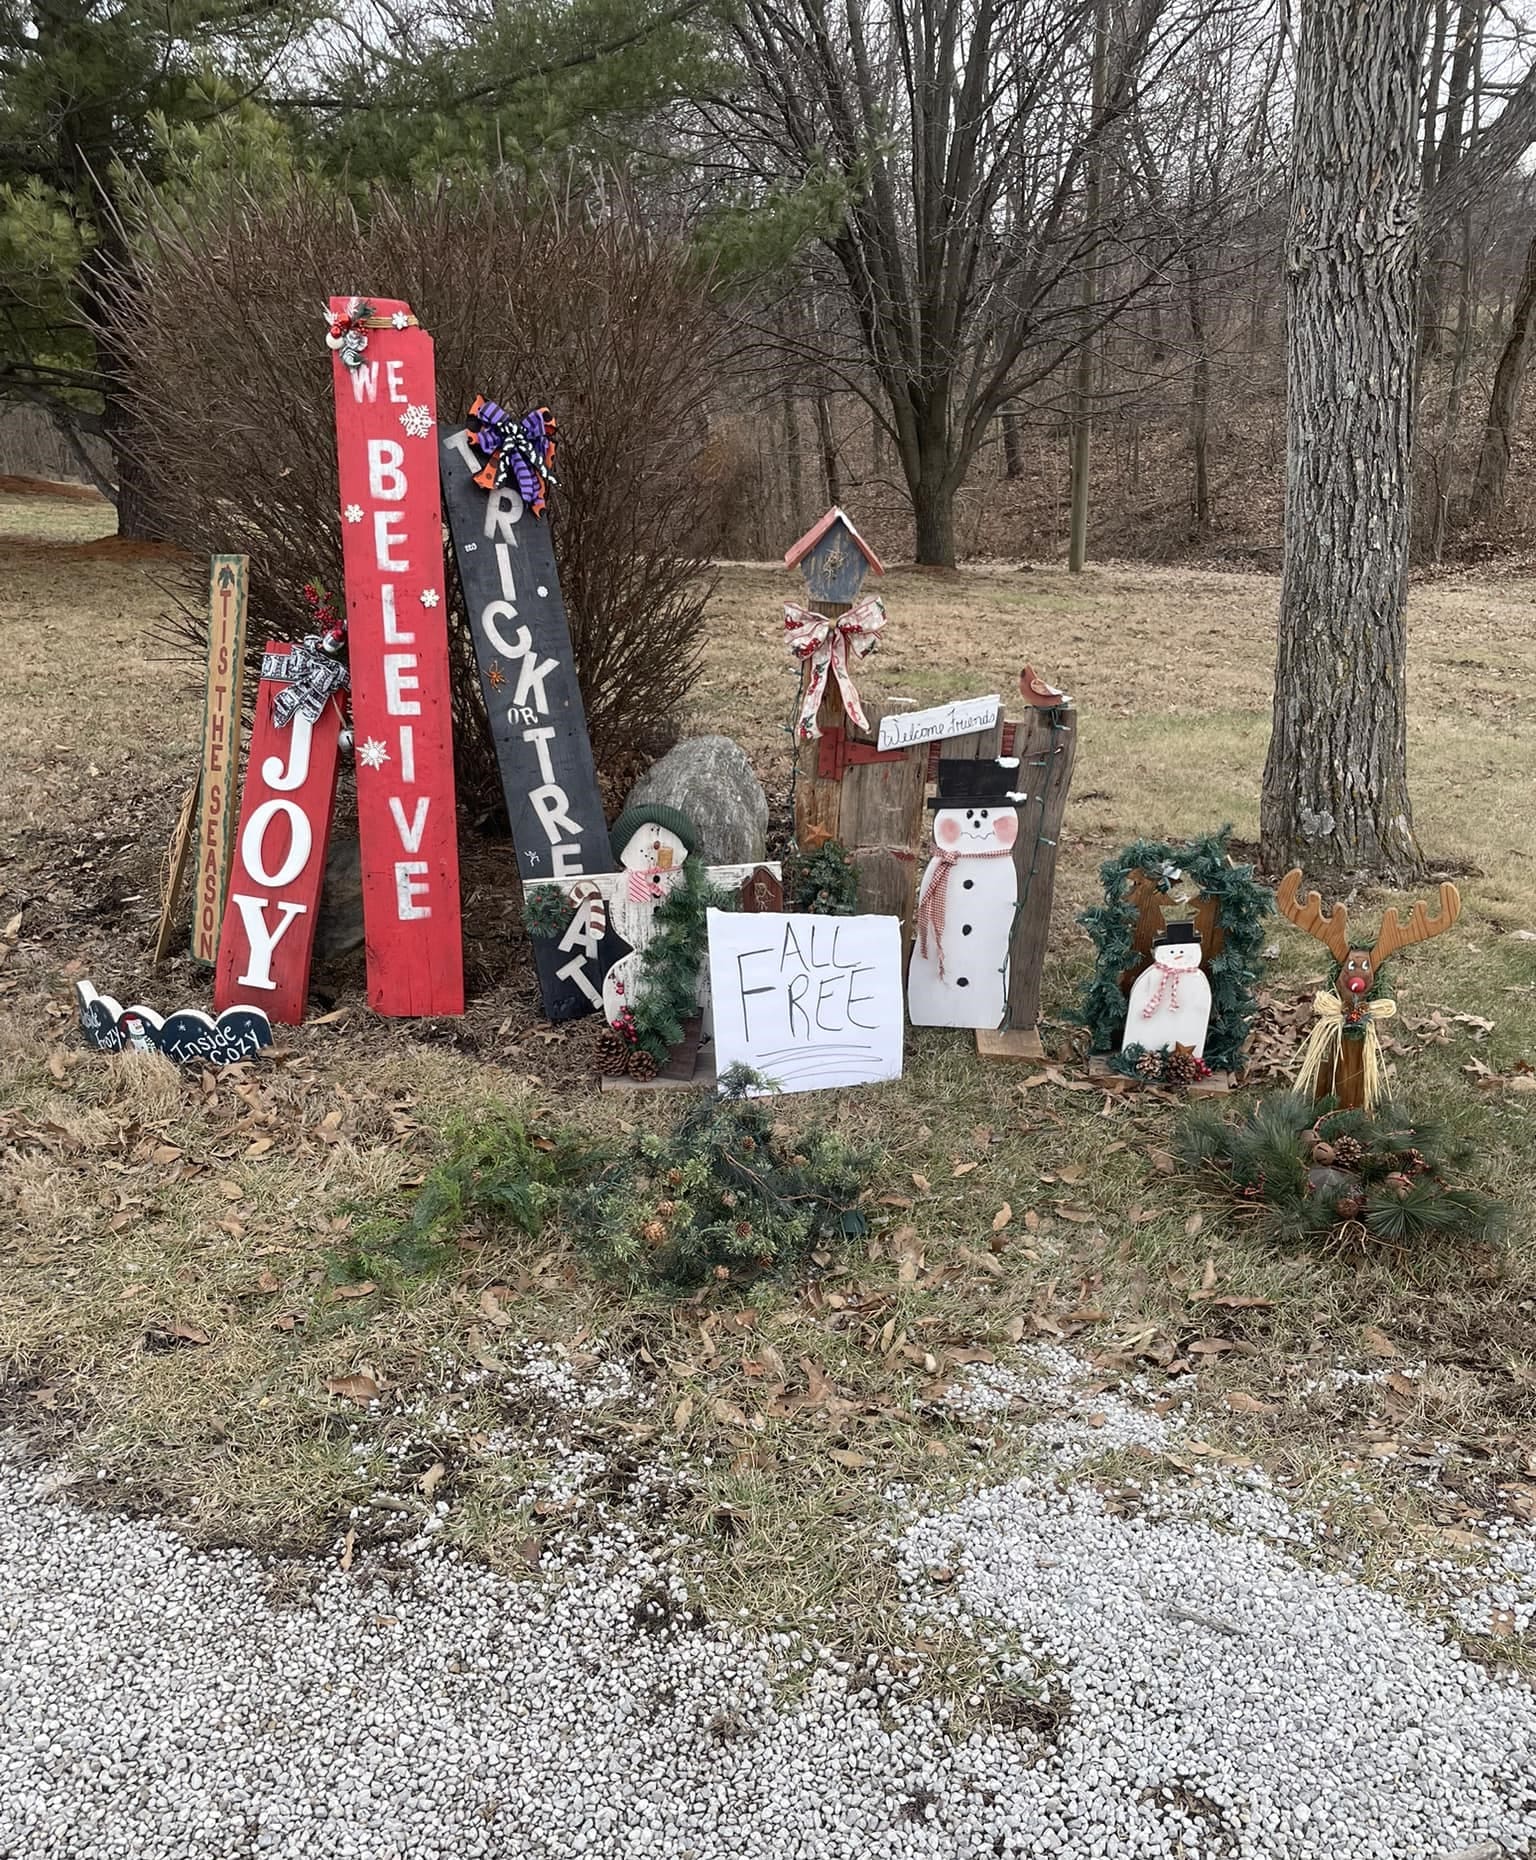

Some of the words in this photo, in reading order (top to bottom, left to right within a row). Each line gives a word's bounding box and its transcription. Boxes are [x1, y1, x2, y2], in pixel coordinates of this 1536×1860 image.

[350, 361, 408, 403] WE
[443, 428, 561, 714] TRICK
[367, 439, 432, 921] BELEIVE
[507, 706, 539, 726] OR
[210, 686, 227, 771] THE
[880, 719, 945, 747] Welcome
[200, 785, 221, 960] SEASON
[232, 705, 314, 990] JOY
[780, 922, 861, 972] ALL
[737, 948, 880, 1042] FREE
[170, 1026, 236, 1063] Inside
